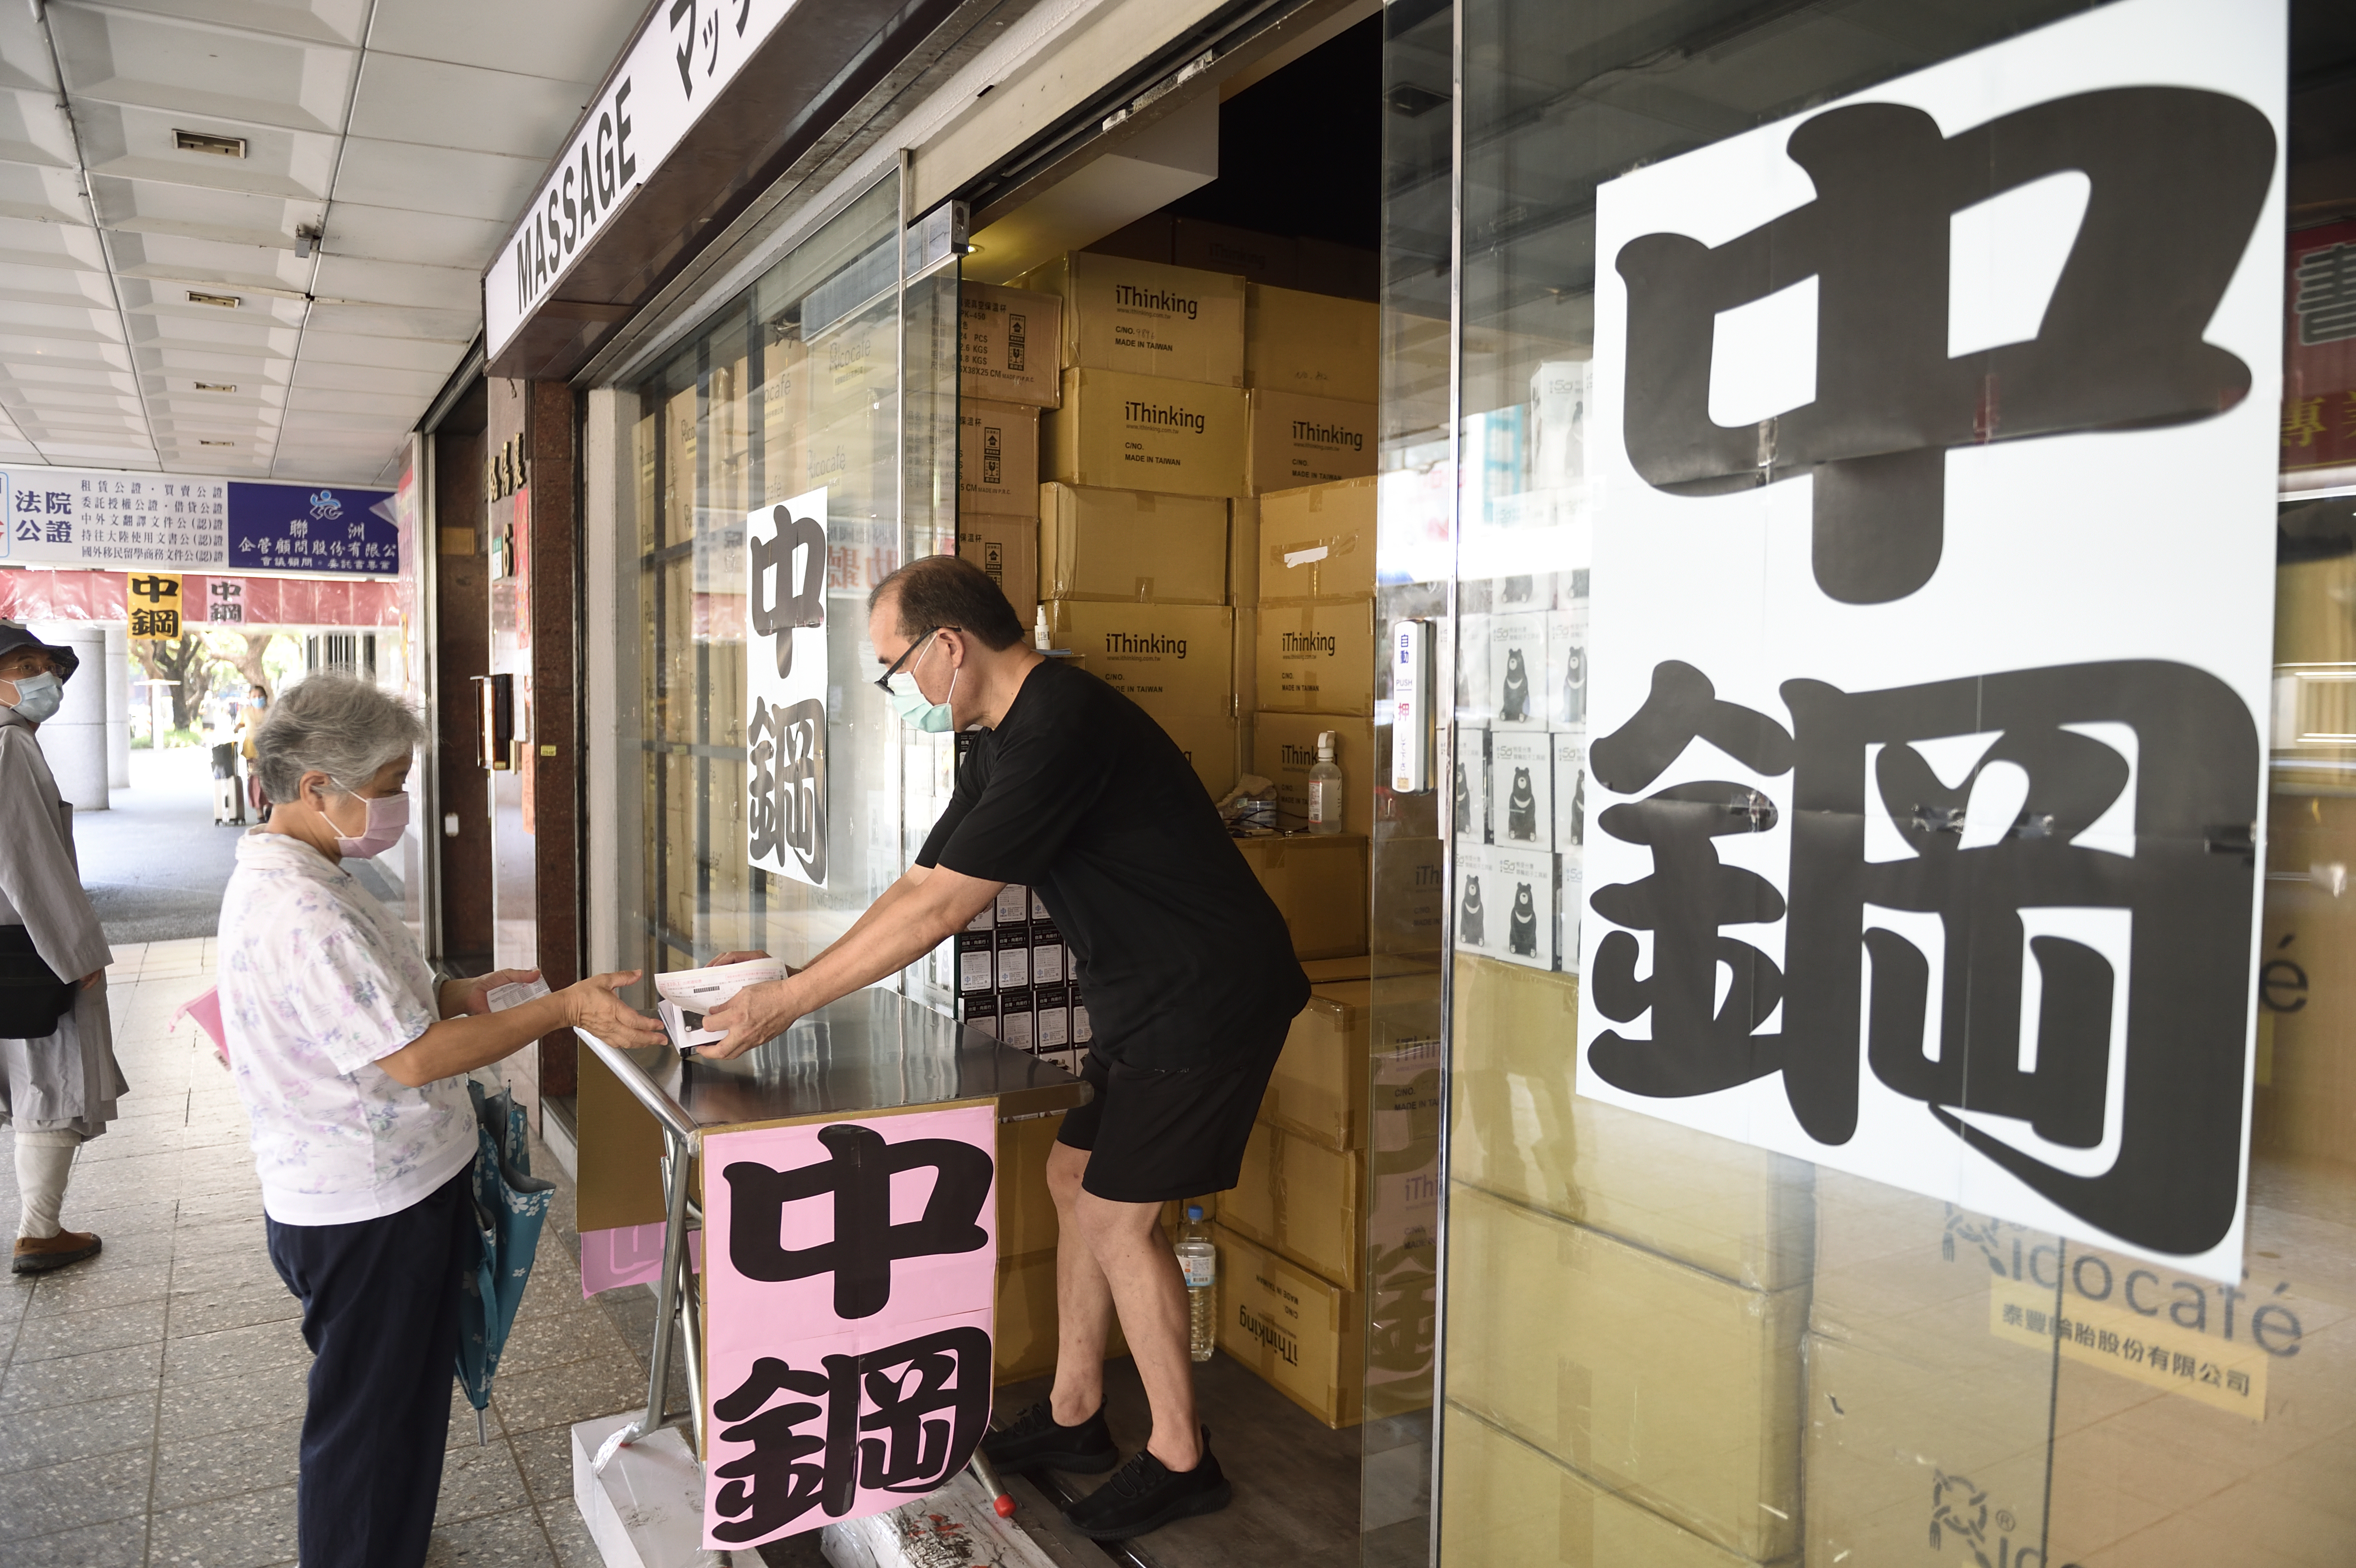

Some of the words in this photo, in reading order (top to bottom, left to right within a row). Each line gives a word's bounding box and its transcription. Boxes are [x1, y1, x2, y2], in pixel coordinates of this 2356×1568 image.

[516, 75, 636, 316] MASSAGE
[1116, 284, 1198, 320] iThinking
[974, 334, 988, 343] PCS
[1116, 326, 1135, 335] C/NO.
[973, 345, 988, 354] KGS
[1115, 338, 1136, 347] MADE
[1146, 341, 1173, 352] TAIWAN
[972, 356, 987, 365] KGS
[990, 370, 1001, 378] CM
[1125, 401, 1204, 434] iThinking
[1293, 421, 1363, 451] iThinking
[1125, 454, 1145, 462] MADE
[1155, 457, 1180, 466] TAIWAN
[966, 484, 977, 492] CM
[15, 490, 72, 515] 法院
[15, 519, 73, 544] 公證
[503, 523, 514, 577] 6
[131, 575, 179, 638] 中鋼
[209, 581, 242, 622] 中鋼
[1106, 632, 1187, 659] iThinking
[1283, 631, 1335, 656] iThinking
[1401, 634, 1409, 664] 自動
[1588, 85, 2277, 1255] 中鋼
[748, 505, 827, 885] 中鋼
[1396, 679, 1412, 687] PUSH
[1398, 702, 1409, 721] 押
[1395, 1101, 1417, 1111] MADE
[1256, 1274, 1276, 1292] TAIWAN
[1276, 1286, 1282, 1295] IN
[1283, 1291, 1298, 1305] MADE
[712, 1124, 994, 1543] 中鋼
[1240, 1305, 1298, 1367] iThinking
